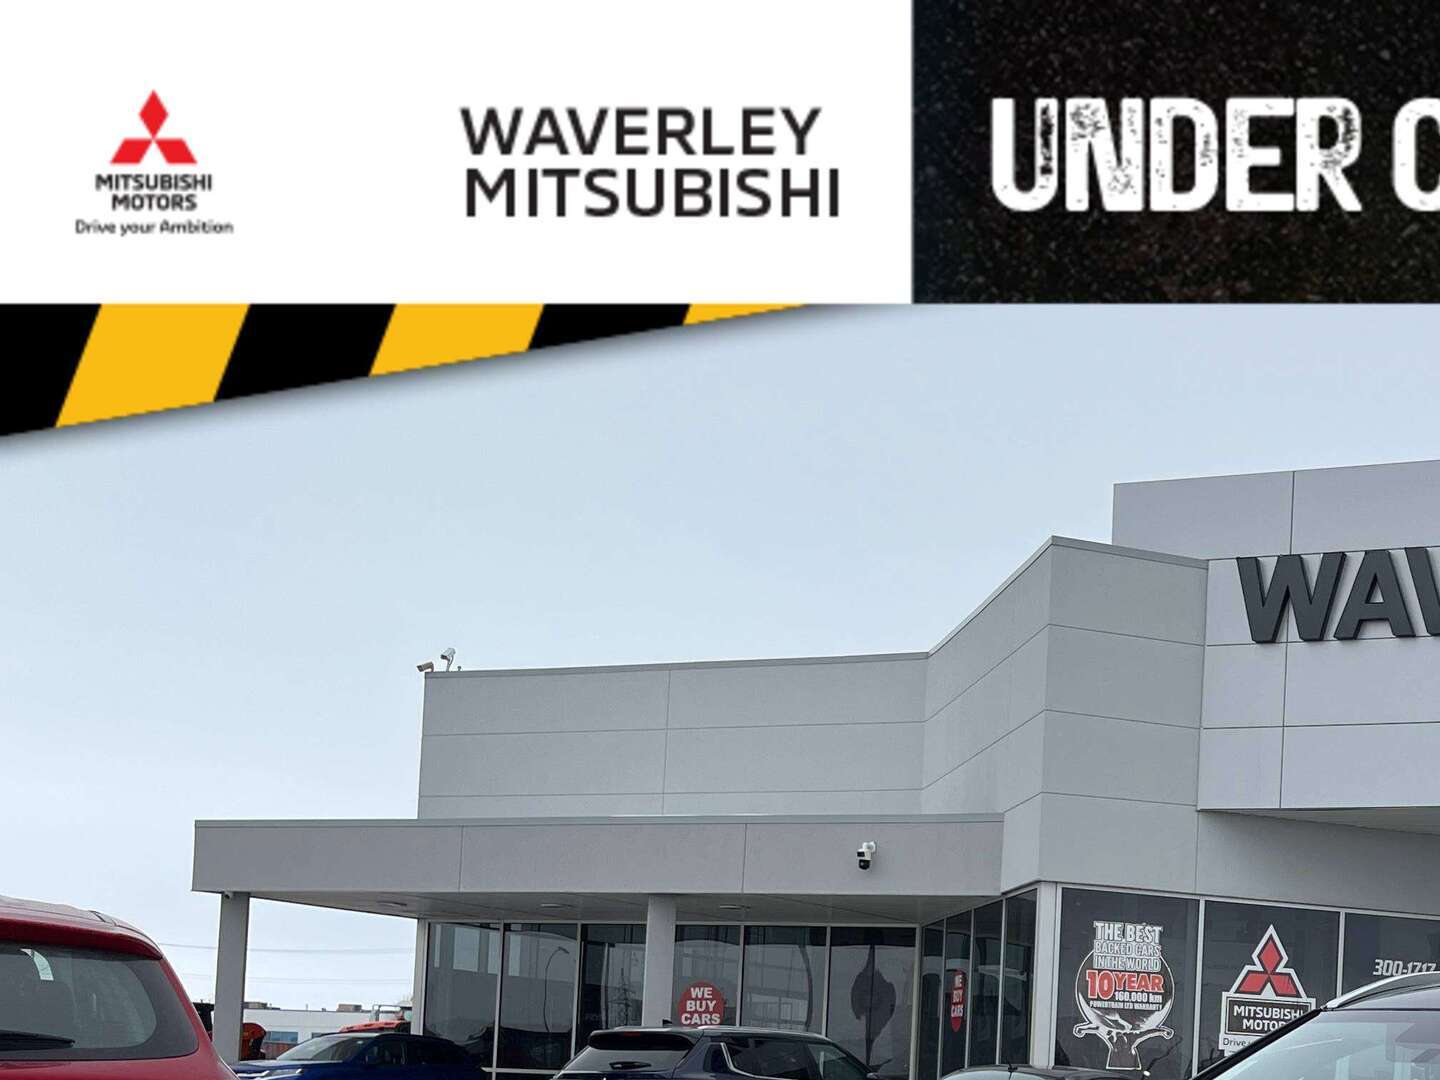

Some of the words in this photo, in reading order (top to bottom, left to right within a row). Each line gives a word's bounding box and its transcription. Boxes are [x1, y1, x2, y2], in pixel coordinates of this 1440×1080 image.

[1094, 921, 1123, 941] THE
[1125, 924, 1162, 945] BEST
[1094, 940, 1133, 955] BACKED
[1135, 944, 1161, 957] CARS
[1126, 957, 1161, 972] WORLD
[1086, 969, 1115, 1000] 10
[1113, 972, 1164, 992] YEAR
[691, 987, 713, 998] WE
[686, 1000, 716, 1011] BUY
[1233, 1005, 1304, 1020] MITSUBISHI
[681, 1013, 720, 1025] CARS
[1242, 1018, 1287, 1031] MOTO
[1223, 1038, 1246, 1047] Drive
